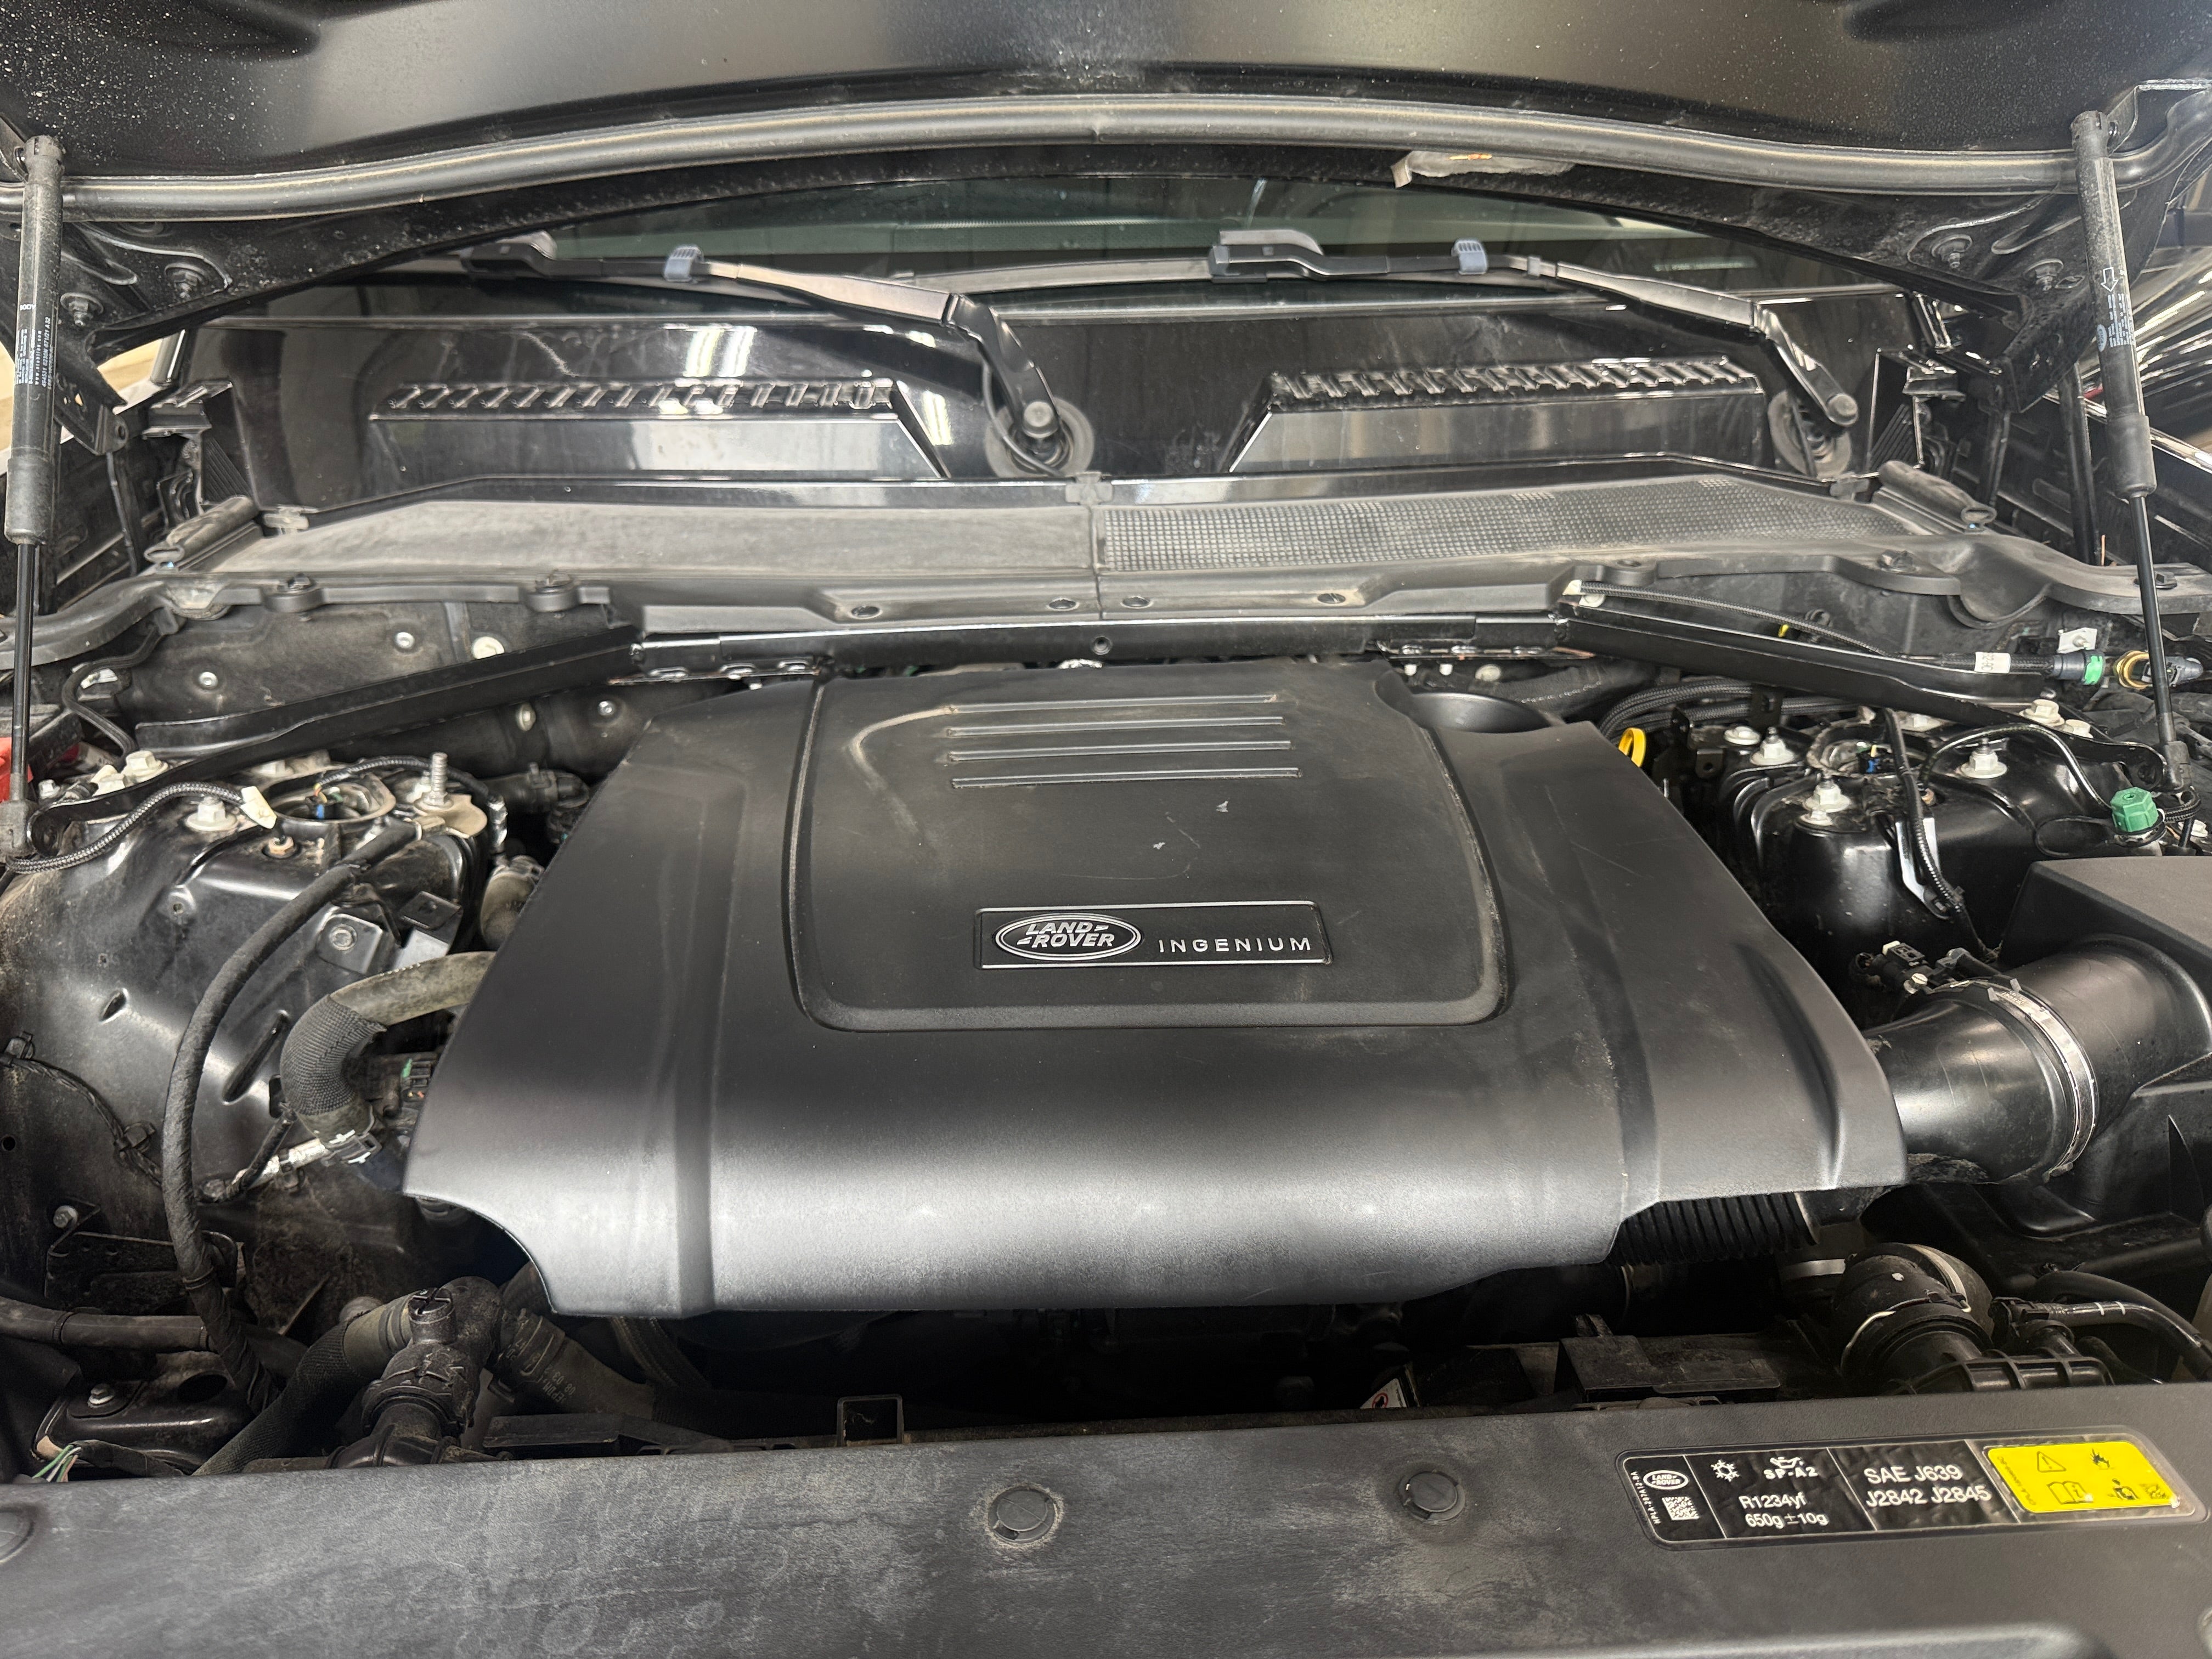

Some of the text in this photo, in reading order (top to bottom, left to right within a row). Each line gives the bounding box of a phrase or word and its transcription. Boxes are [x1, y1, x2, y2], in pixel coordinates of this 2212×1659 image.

[1026, 922, 1096, 935] LAND
[1031, 933, 1115, 947] ROVER
[1158, 937, 1311, 953] INGENIUM
[1763, 1466, 1819, 1480] SP-A2
[1864, 1464, 1963, 1483] SAE J639
[1739, 1491, 1807, 1510] R1234yf
[1866, 1485, 1993, 1507] J2842 J2845
